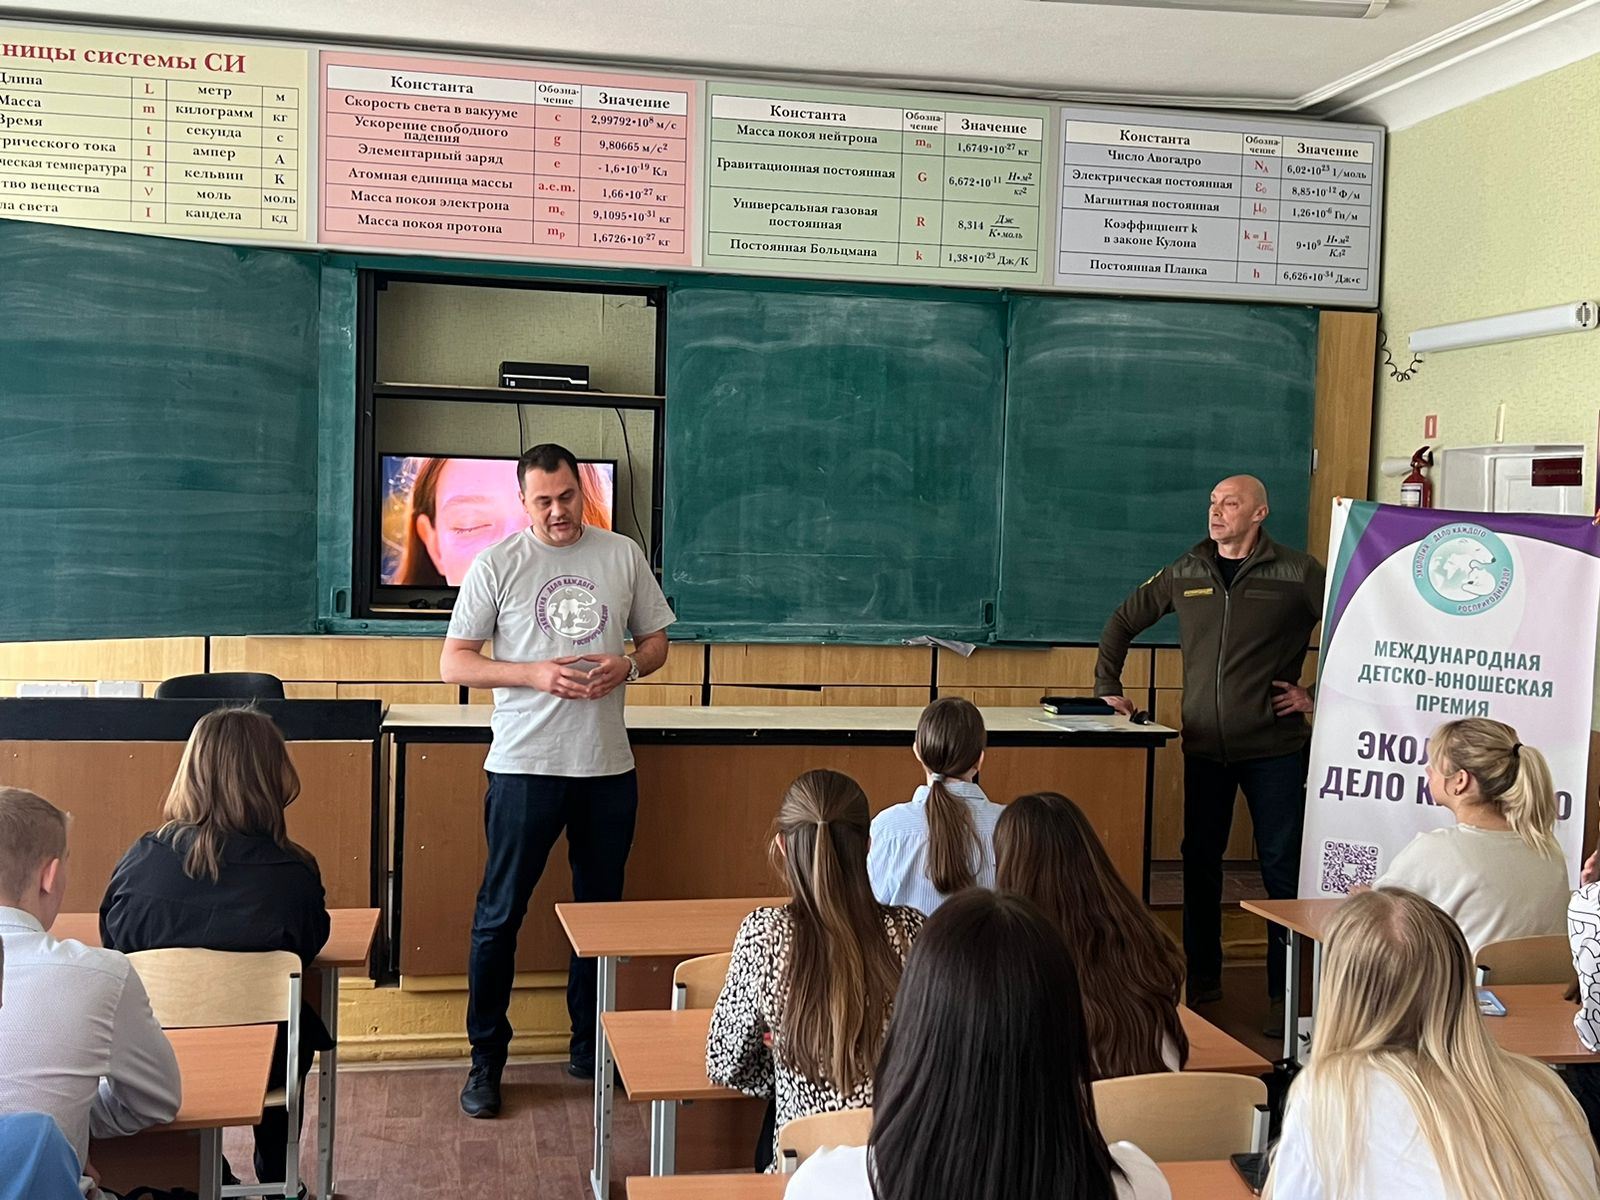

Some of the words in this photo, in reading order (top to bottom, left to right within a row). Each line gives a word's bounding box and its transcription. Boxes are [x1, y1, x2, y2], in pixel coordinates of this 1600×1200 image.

[2, 44, 76, 63] ницы
[84, 49, 196, 70] системы
[204, 53, 246, 73] СИ
[145, 84, 154, 94] L
[391, 76, 473, 93] Константа
[198, 87, 232, 98] метр
[276, 93, 285, 102] м
[543, 96, 573, 105] чение
[599, 92, 670, 109] Значение
[143, 105, 155, 113] m
[176, 105, 253, 119] килограмм
[345, 95, 410, 111] Скорость
[414, 103, 450, 113] света
[465, 107, 518, 120] вакууме
[770, 105, 846, 121] Константа
[273, 113, 287, 122] кг
[146, 126, 151, 135] t
[186, 125, 242, 139] секунда
[354, 116, 427, 131] Ускорение
[430, 124, 508, 137] свободного
[657, 120, 676, 131] м/с
[910, 123, 938, 131] чение
[961, 119, 1027, 134] Значение
[404, 131, 460, 144] падения
[554, 135, 560, 146] g
[737, 124, 775, 137] Масса
[778, 129, 815, 140] покоя
[819, 132, 878, 145] нейтрона
[1120, 130, 1190, 145] Константа
[3, 138, 79, 150] рического
[83, 142, 116, 152] тока
[1297, 143, 1358, 157] Значение
[193, 147, 236, 159] ампер
[358, 144, 462, 163] Элементарный
[465, 154, 503, 166] заряд
[1108, 150, 1144, 161] Число
[1147, 153, 1201, 168] Авогадро
[0, 158, 42, 168] ческая
[46, 161, 127, 176] температура
[144, 167, 154, 177] T
[652, 167, 668, 177] Кл
[717, 157, 819, 174] Гравитационная
[823, 166, 895, 178] постоянная
[185, 169, 243, 181] кельвин
[349, 168, 407, 182] Атомная
[411, 174, 467, 186] единица
[472, 178, 512, 189] массы
[918, 172, 927, 182] G
[1072, 170, 1162, 185] Электрическая
[1165, 178, 1232, 189] постоянная
[2, 181, 26, 189] тво
[31, 182, 100, 193] вещества
[197, 190, 231, 200] моль
[263, 195, 296, 205] моль
[351, 190, 392, 203] Масса
[396, 197, 436, 206] покоя
[440, 199, 509, 212] электрона
[656, 194, 668, 202] кг
[0, 202, 14, 210] ла
[19, 202, 58, 212] света
[733, 198, 828, 213] Универсальная
[832, 207, 878, 216] газовая
[1084, 194, 1148, 207] Магнитная
[1152, 200, 1220, 212] постоянная
[186, 209, 242, 221] кандела
[271, 213, 287, 224] кд
[659, 216, 671, 224] кг
[917, 217, 925, 226] R
[358, 214, 398, 227] Масса
[403, 220, 442, 229] покоя
[447, 224, 502, 234] протона
[769, 218, 842, 230] постоянная
[958, 221, 984, 230] 8,314
[1104, 218, 1189, 233] Коэффициент
[1192, 224, 1198, 233] k
[659, 239, 670, 247] кг
[730, 239, 806, 253] Постоянная
[810, 244, 877, 257] Больцмана
[1113, 237, 1152, 245] законе
[1156, 237, 1197, 249] Кулона
[916, 251, 922, 260] k
[1090, 259, 1161, 272] Постоянная
[1165, 263, 1207, 275] Планка
[1254, 269, 1259, 278] h
[1433, 529, 1451, 542] ДЕЛО
[1453, 527, 1486, 537] КАЖДОГО
[1375, 640, 1541, 671] МЕЖДУНАРОДНАЯ
[1358, 664, 1553, 698] ДЕТСКО-ЮНОШЕСКАЯ
[1416, 694, 1489, 717] ПРЕМИЯ
[1320, 766, 1404, 801] ДЕЛО
